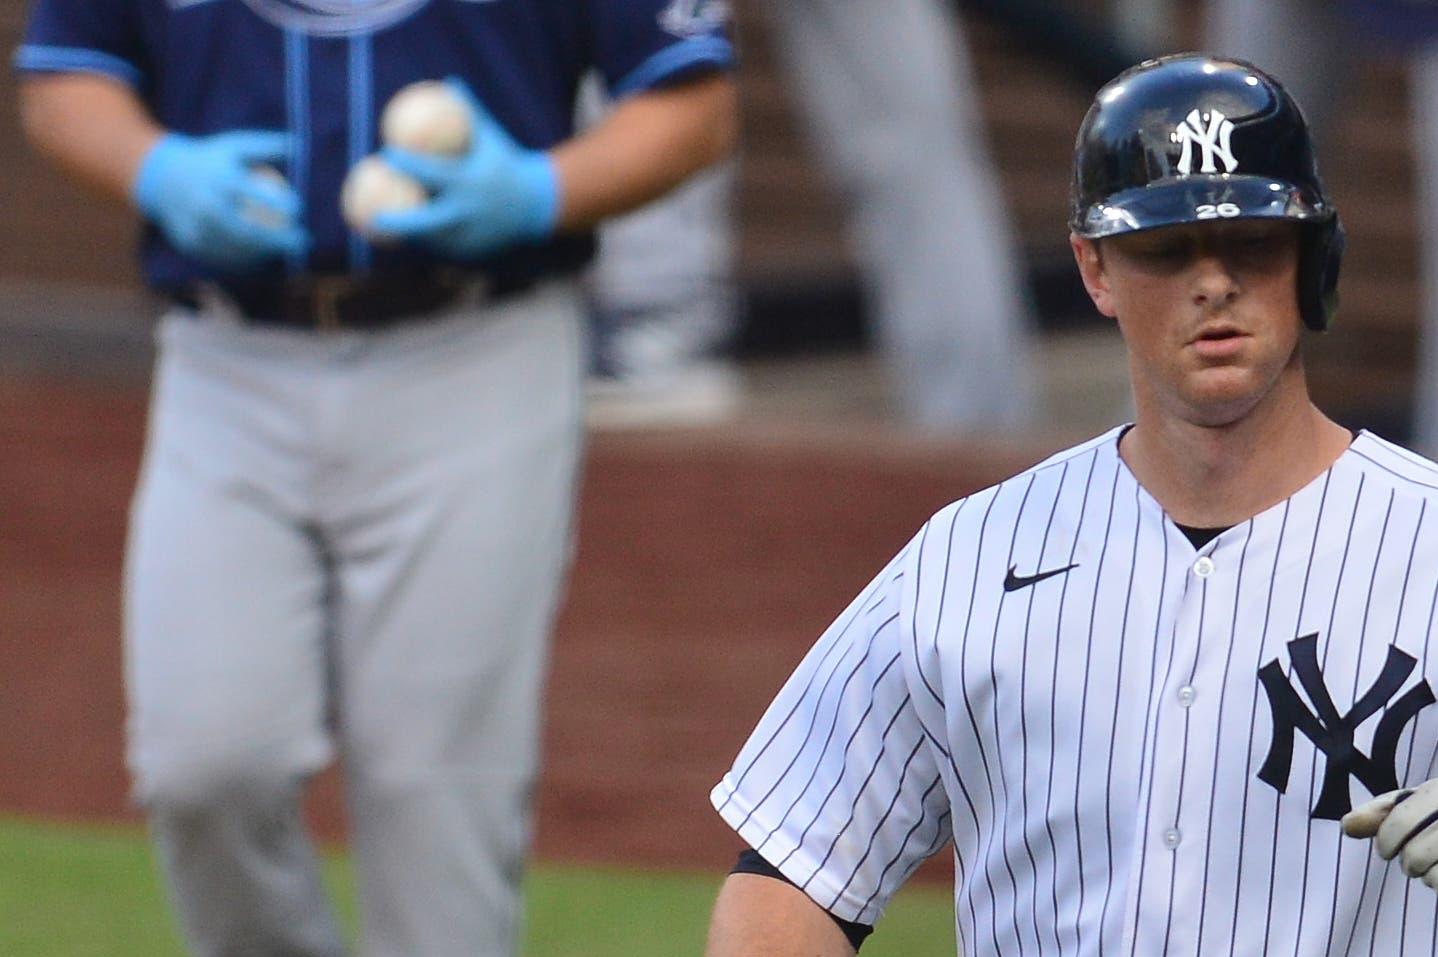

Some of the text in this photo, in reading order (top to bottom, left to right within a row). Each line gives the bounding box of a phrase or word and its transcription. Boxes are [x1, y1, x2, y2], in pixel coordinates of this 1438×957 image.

[1176, 108, 1239, 175] NY
[1195, 203, 1240, 219] 26
[1257, 631, 1437, 821] NY
